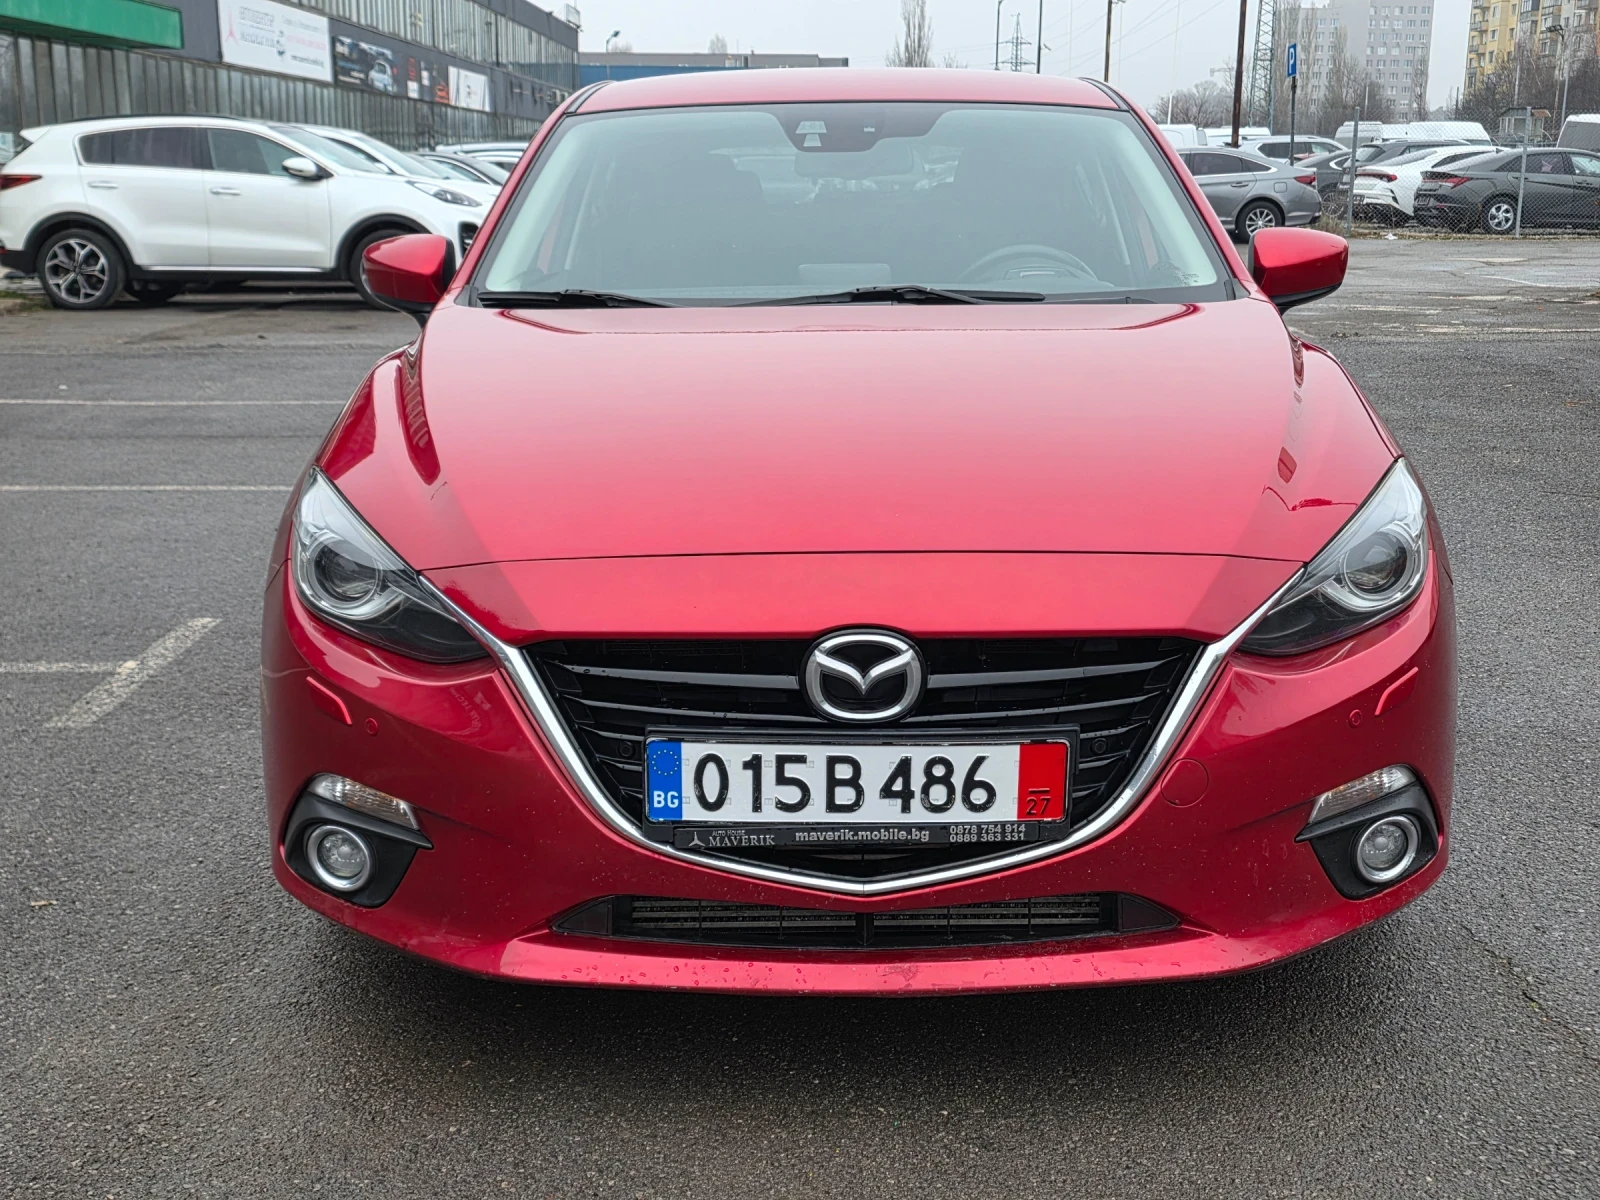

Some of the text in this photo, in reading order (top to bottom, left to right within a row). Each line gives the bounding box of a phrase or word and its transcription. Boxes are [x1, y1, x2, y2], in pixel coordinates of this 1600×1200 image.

[1289, 47, 1295, 74] P
[653, 791, 679, 808] BG
[1026, 796, 1051, 816] 27
[795, 829, 930, 843] maverik.mobile.bg
[950, 824, 1026, 835] 0878 754 914
[708, 835, 776, 848] MAVERIK
[950, 832, 1025, 843] 0889 363 331
